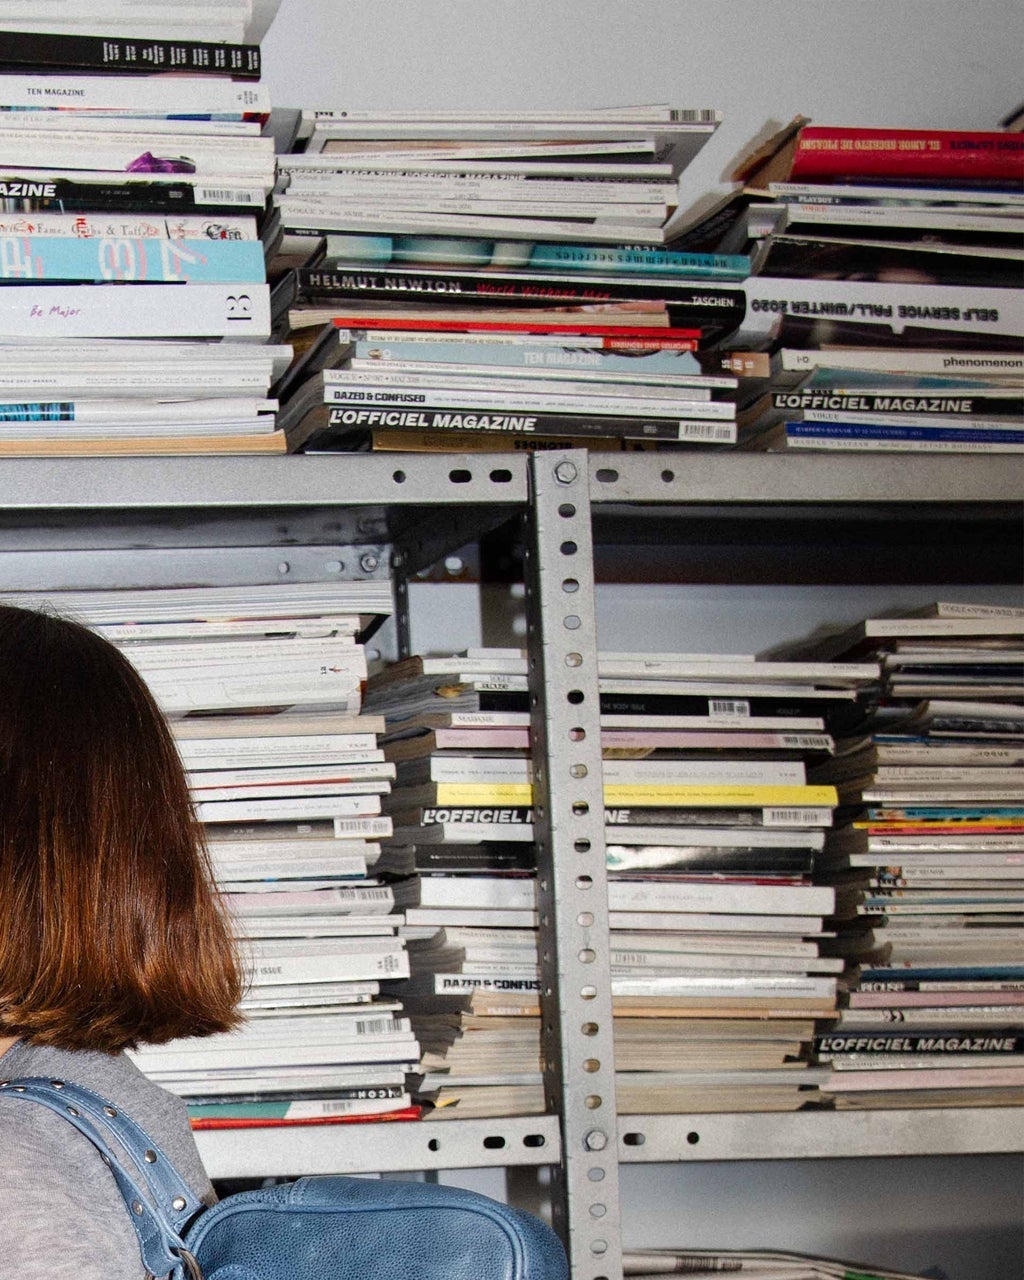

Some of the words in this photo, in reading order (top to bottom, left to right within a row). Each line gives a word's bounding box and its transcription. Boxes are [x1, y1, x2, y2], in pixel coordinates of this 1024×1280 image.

[44, 89, 86, 97] MAGAZINE
[309, 274, 378, 289] HELMUT
[384, 277, 462, 294] NEWTON
[691, 295, 734, 308] TASCHEN
[48, 304, 81, 318] Major
[750, 298, 788, 313] 2020
[791, 300, 894, 319] FALL/WINTER
[897, 305, 961, 321] SERVICE
[963, 307, 999, 322] SELF
[524, 352, 546, 364] TEN
[546, 353, 603, 367] MAGAZINE
[943, 357, 1024, 369] phenomenon
[334, 390, 365, 401] DAZED
[366, 391, 374, 401] &
[374, 392, 426, 403] CONFUSED
[775, 394, 870, 410] L'OFFICIEL
[873, 396, 973, 413] MAGAZINE
[329, 409, 429, 427] L'OFFICIEL
[432, 414, 538, 432] MAGAZINE
[423, 809, 523, 824] L'OFFICIEL
[259, 965, 283, 975] ISSUE
[493, 980, 542, 991] CONFUS
[819, 1037, 913, 1052] L'OFFICIEL
[915, 1036, 1017, 1052] MAGAZINE
